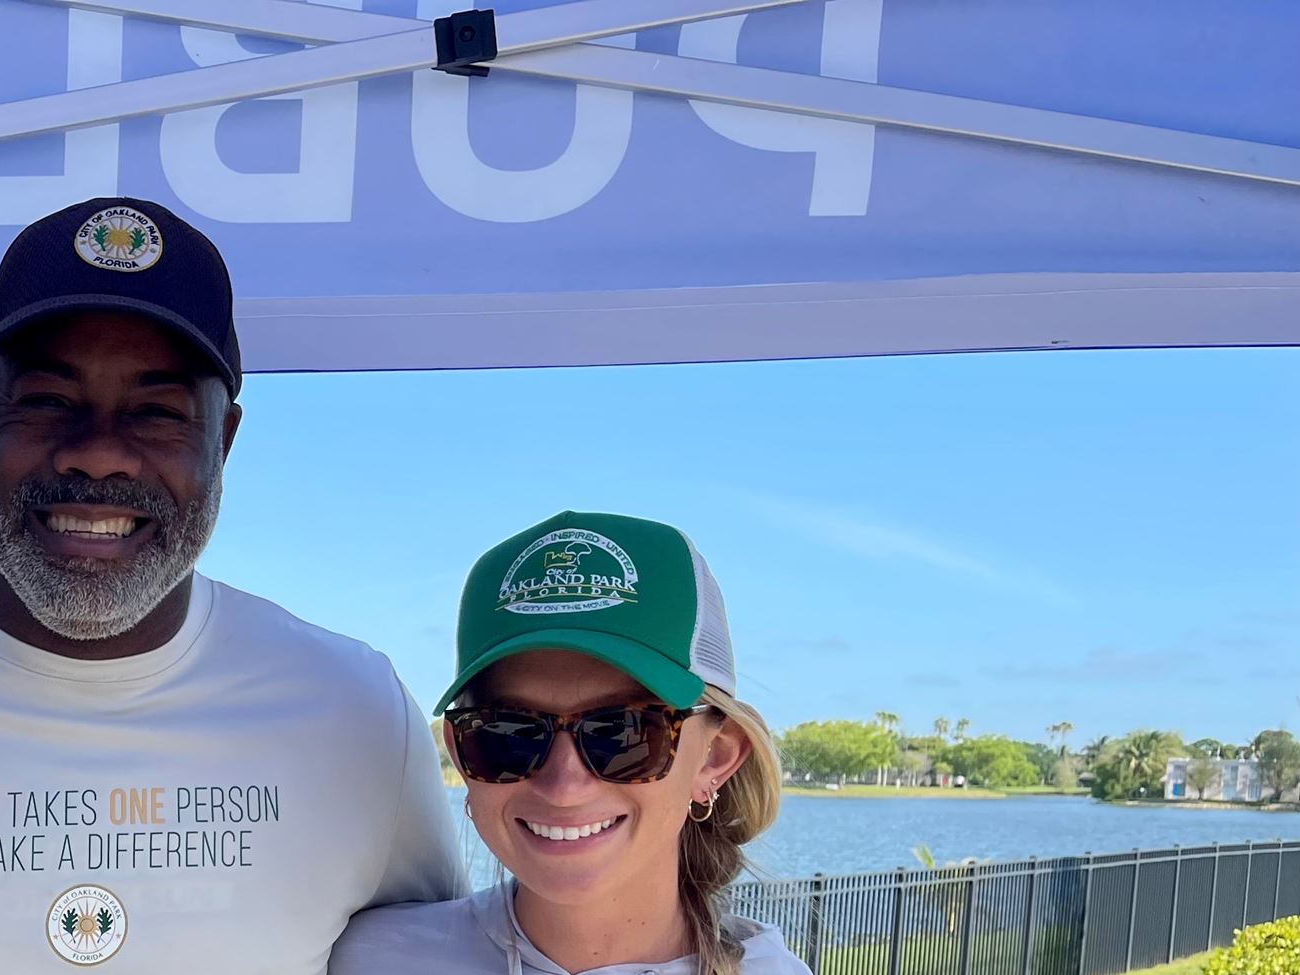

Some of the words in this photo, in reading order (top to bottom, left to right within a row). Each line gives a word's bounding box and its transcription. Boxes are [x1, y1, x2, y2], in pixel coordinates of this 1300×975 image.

[79, 223, 93, 238] CITY
[92, 214, 103, 223] OF
[105, 209, 148, 225] OAKLAND
[146, 226, 160, 245] PARK
[93, 256, 140, 269] FLORIDA
[551, 531, 600, 542] INSPIRED
[606, 541, 635, 575] UNITED
[499, 574, 585, 599] OAKLAND
[590, 574, 638, 592] PARK
[510, 587, 620, 602] FLORIDA
[583, 600, 610, 609] MOVE
[7, 789, 98, 828] TAKES
[108, 787, 166, 826] ONE
[176, 785, 280, 824] PERSON
[58, 834, 75, 871] A
[88, 830, 253, 871] DIFFERENCE
[52, 904, 63, 921] CITY
[71, 889, 109, 901] OAKLAND
[109, 901, 123, 919] PARK
[72, 952, 104, 961] FLORIDA
